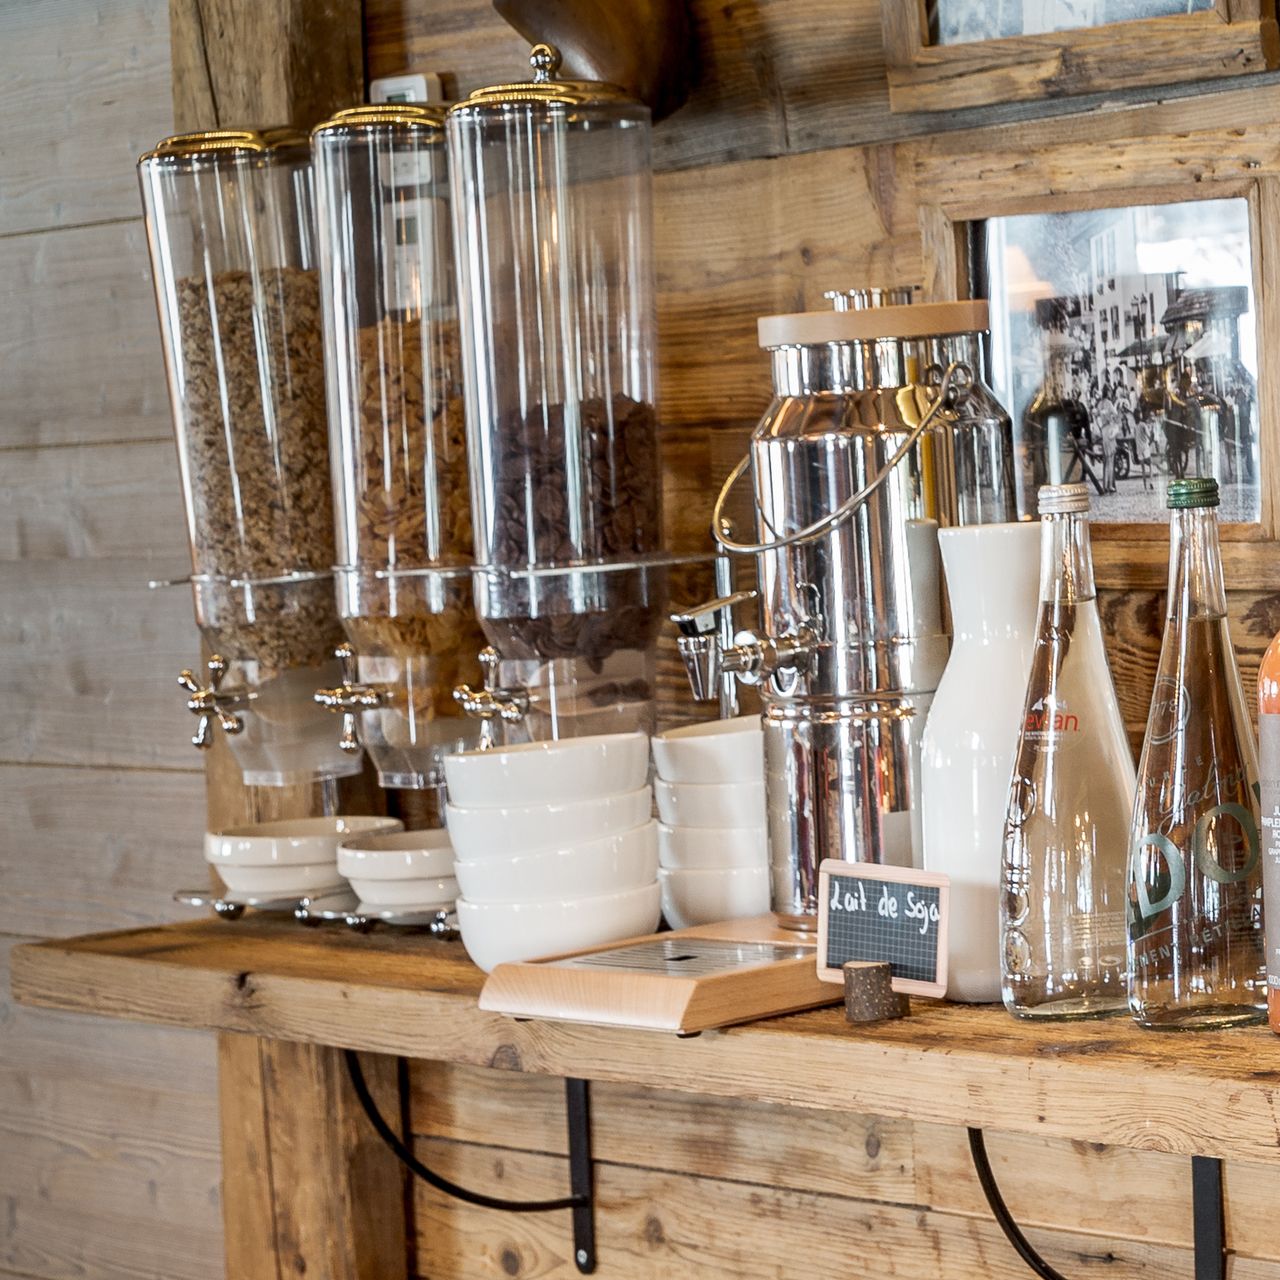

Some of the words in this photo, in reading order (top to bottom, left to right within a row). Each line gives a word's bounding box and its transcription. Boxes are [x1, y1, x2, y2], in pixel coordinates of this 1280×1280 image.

[1026, 714, 1078, 731] evan
[830, 881, 867, 912] Lait
[878, 885, 898, 918] de
[904, 891, 941, 934] Soja
